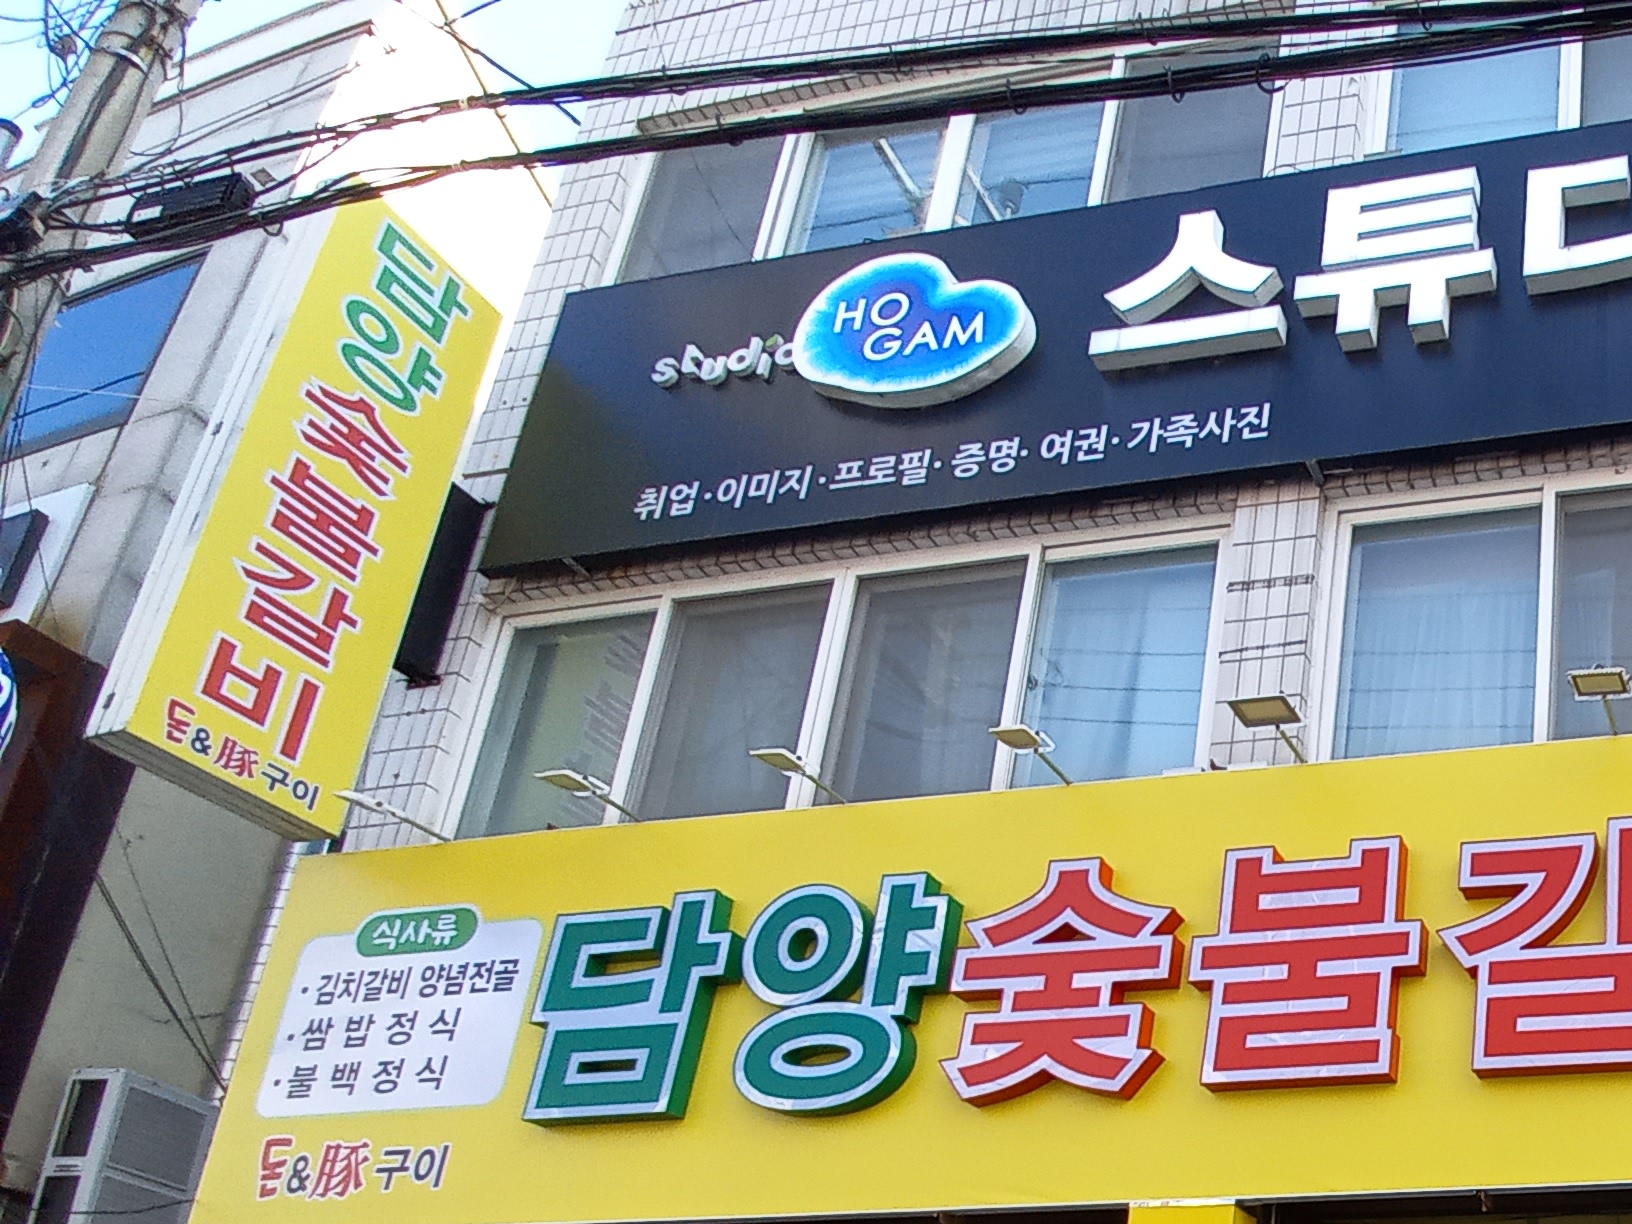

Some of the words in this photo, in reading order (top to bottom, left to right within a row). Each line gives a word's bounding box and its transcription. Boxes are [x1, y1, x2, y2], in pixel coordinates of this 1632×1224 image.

[370, 913, 458, 951] 식사류
[314, 966, 414, 1007] 김치갈비
[417, 957, 521, 1000] 양념전골
